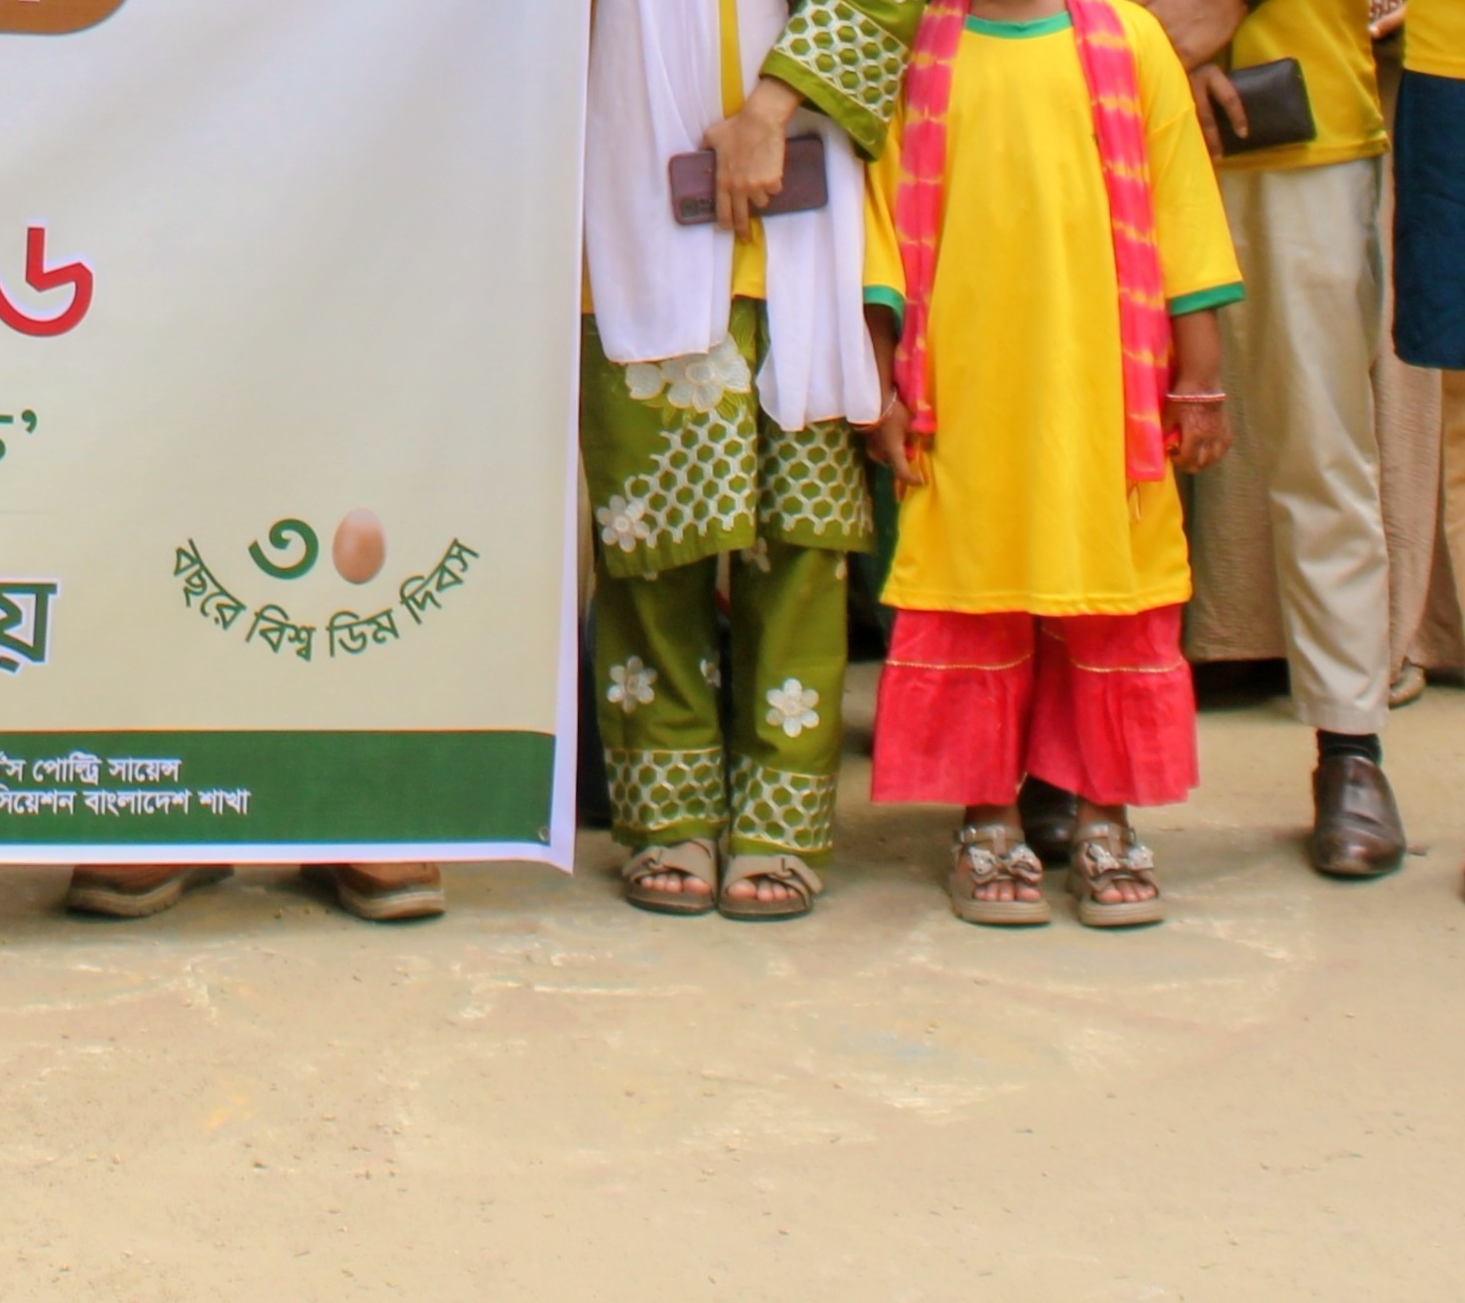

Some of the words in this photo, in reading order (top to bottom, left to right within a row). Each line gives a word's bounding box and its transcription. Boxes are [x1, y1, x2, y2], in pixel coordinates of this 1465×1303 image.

[248, 518, 319, 580] ৩
[174, 538, 247, 630] বছরে
[245, 604, 317, 662] বিশ্ব
[326, 610, 400, 657] ডিম
[399, 538, 480, 624] দিবস
[82, 789, 192, 816] বাংলাদেশ
[198, 789, 251, 816] শাখা
